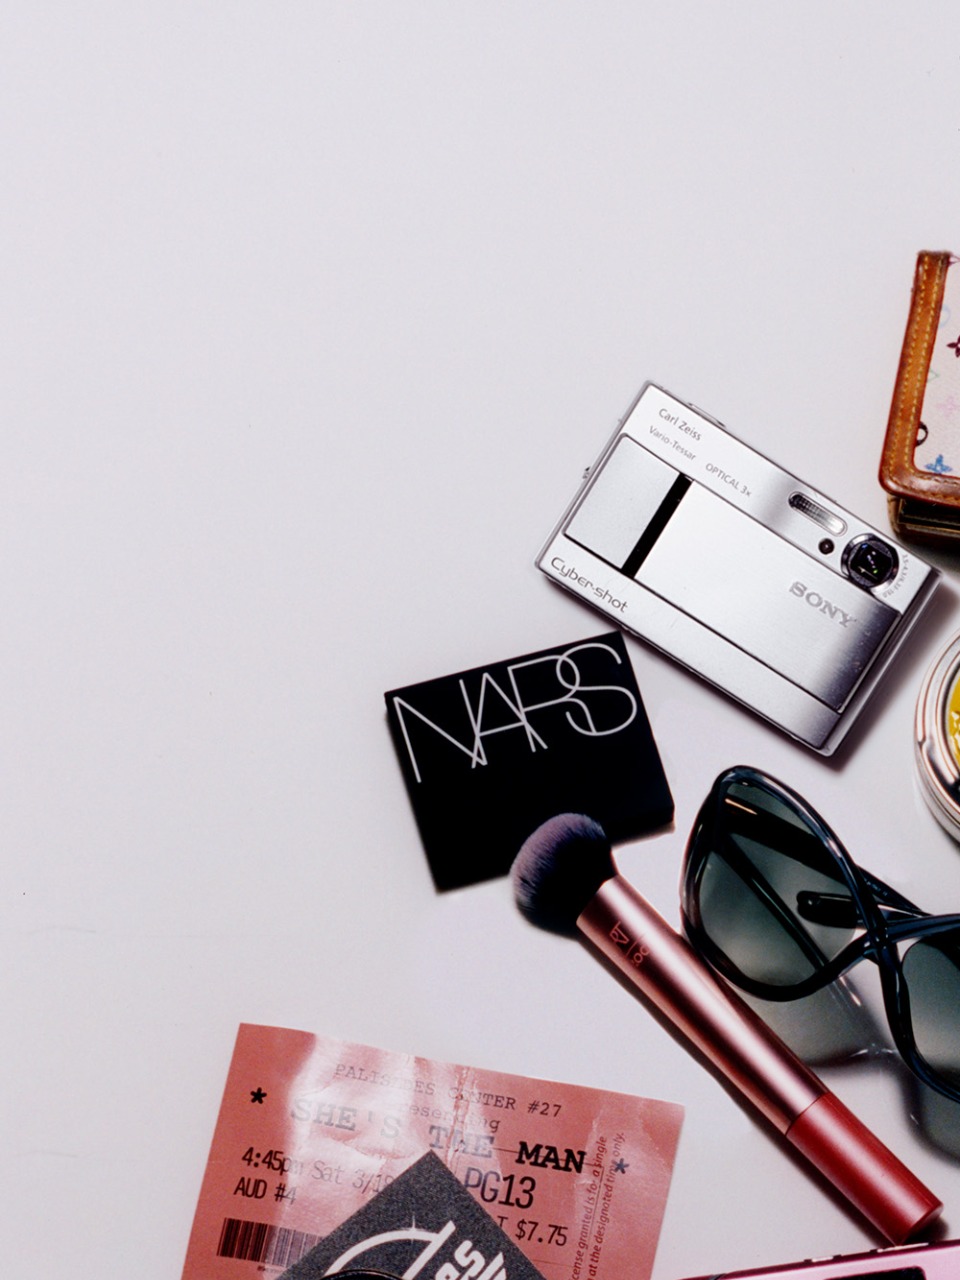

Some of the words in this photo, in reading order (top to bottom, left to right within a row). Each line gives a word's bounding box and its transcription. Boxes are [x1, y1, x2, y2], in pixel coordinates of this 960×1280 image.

[658, 408, 678, 426] Carl
[678, 421, 702, 442] Zeiss
[649, 425, 696, 462] Vario-Tessar
[705, 462, 739, 491] OPTICAL
[550, 556, 629, 614] Cyber-shot
[788, 580, 858, 628] SONY
[393, 642, 638, 784] NARS
[334, 1063, 437, 1097] PALISDES
[447, 1086, 517, 1111] CNTER
[527, 1099, 563, 1118] #27
[428, 1123, 495, 1159] THE
[514, 1141, 588, 1174] MAN
[592, 1135, 608, 1169] single
[612, 1131, 625, 1158] only.
[311, 1160, 345, 1186] Sat
[463, 1166, 537, 1210] PG13
[592, 1168, 600, 1177] a
[233, 1177, 268, 1200] AUD
[274, 1182, 297, 1205] #4
[585, 1194, 595, 1207] is
[578, 1207, 594, 1250] granted
[597, 1184, 614, 1245] designated
[515, 1218, 569, 1247] $7.75
[588, 1263, 598, 1278] at
[590, 1245, 602, 1264] the
